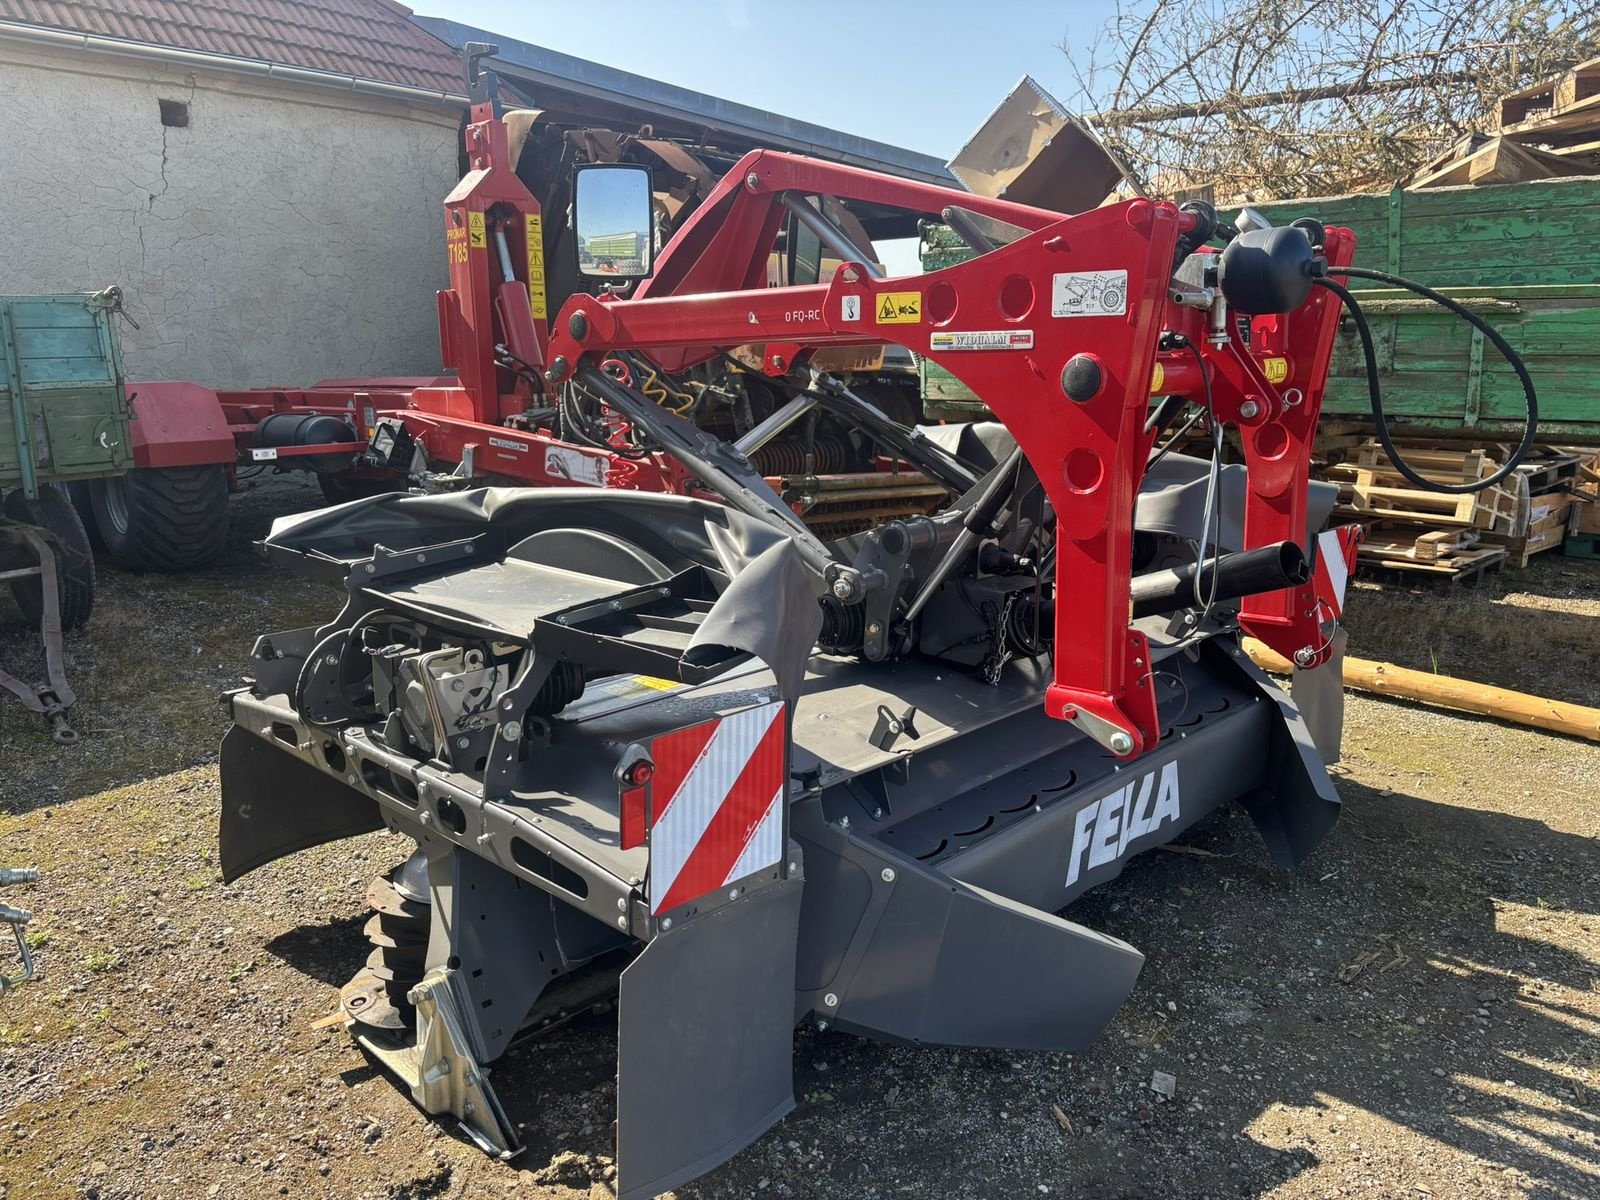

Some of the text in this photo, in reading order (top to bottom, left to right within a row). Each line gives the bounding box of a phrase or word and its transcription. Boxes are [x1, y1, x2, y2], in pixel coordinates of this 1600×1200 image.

[447, 228, 466, 240] PRONAR
[448, 242, 468, 264] T185
[793, 309, 820, 322] FQ-RC
[955, 335, 1007, 345] WIDHALM
[1065, 760, 1180, 888] FELLA
